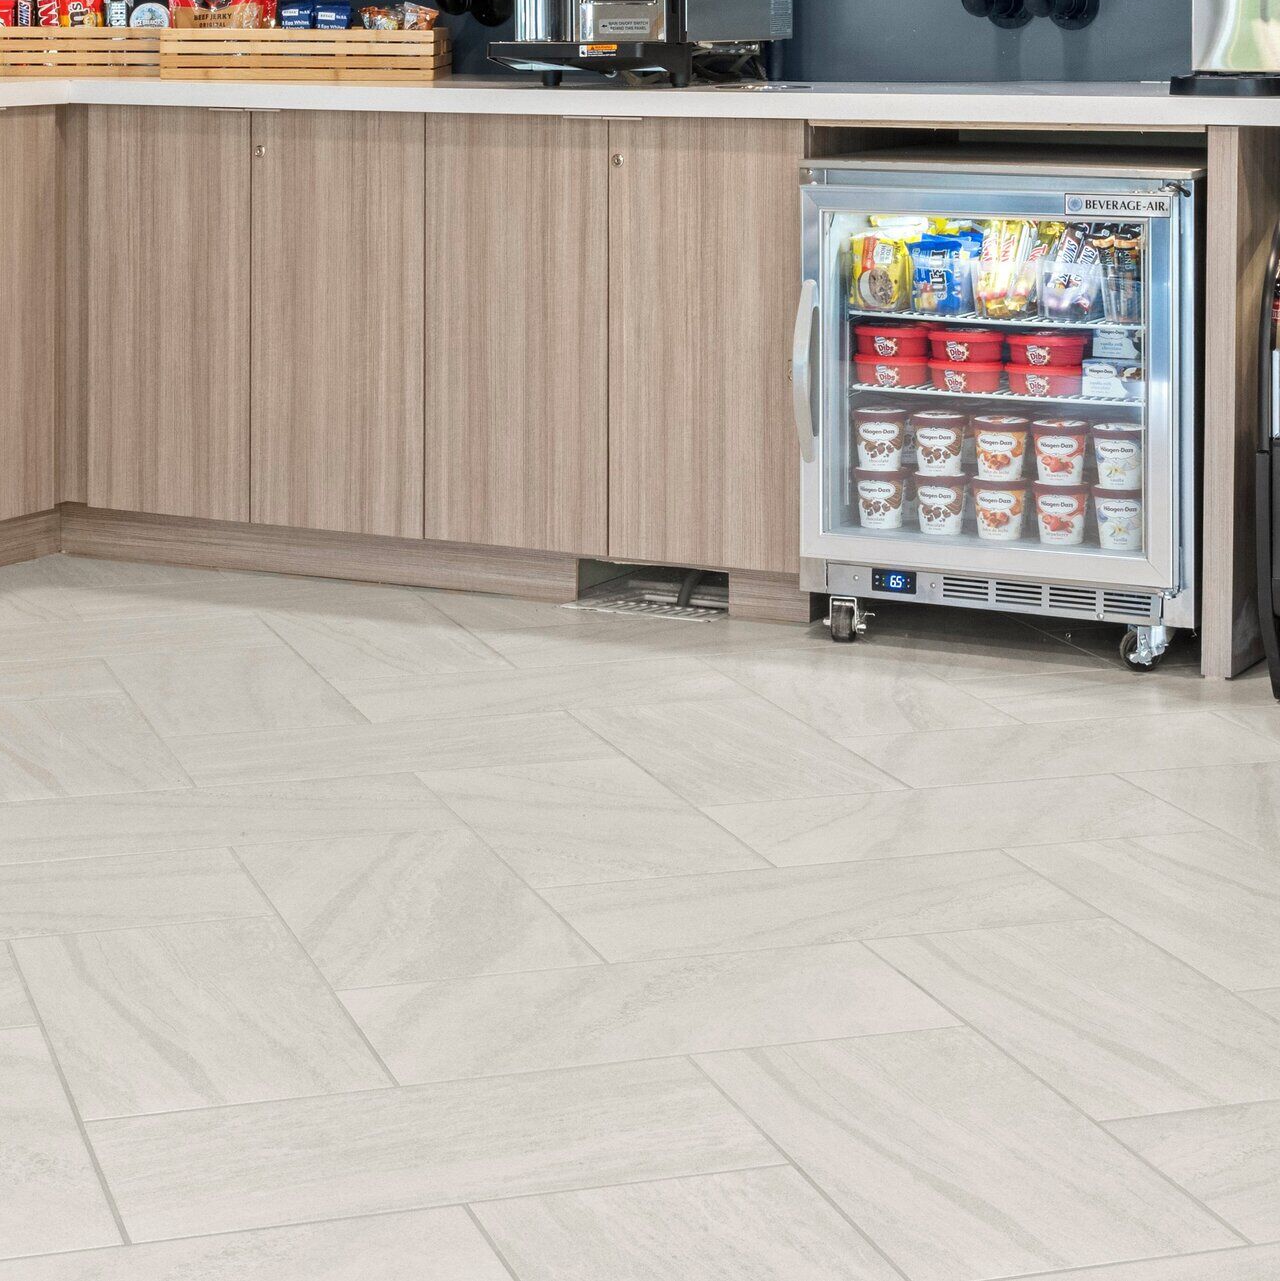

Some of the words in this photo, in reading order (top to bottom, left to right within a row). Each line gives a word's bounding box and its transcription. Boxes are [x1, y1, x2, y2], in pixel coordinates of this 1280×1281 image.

[210, 12, 232, 20] JERKY
[1084, 199, 1167, 213] BEVERAGE-AIR
[877, 343, 895, 353] Dibs
[949, 348, 967, 358] Dibs
[1029, 352, 1047, 362] Dibs
[878, 372, 896, 382] Dibs
[947, 377, 965, 387] Dibs
[1029, 382, 1046, 392] Dibs
